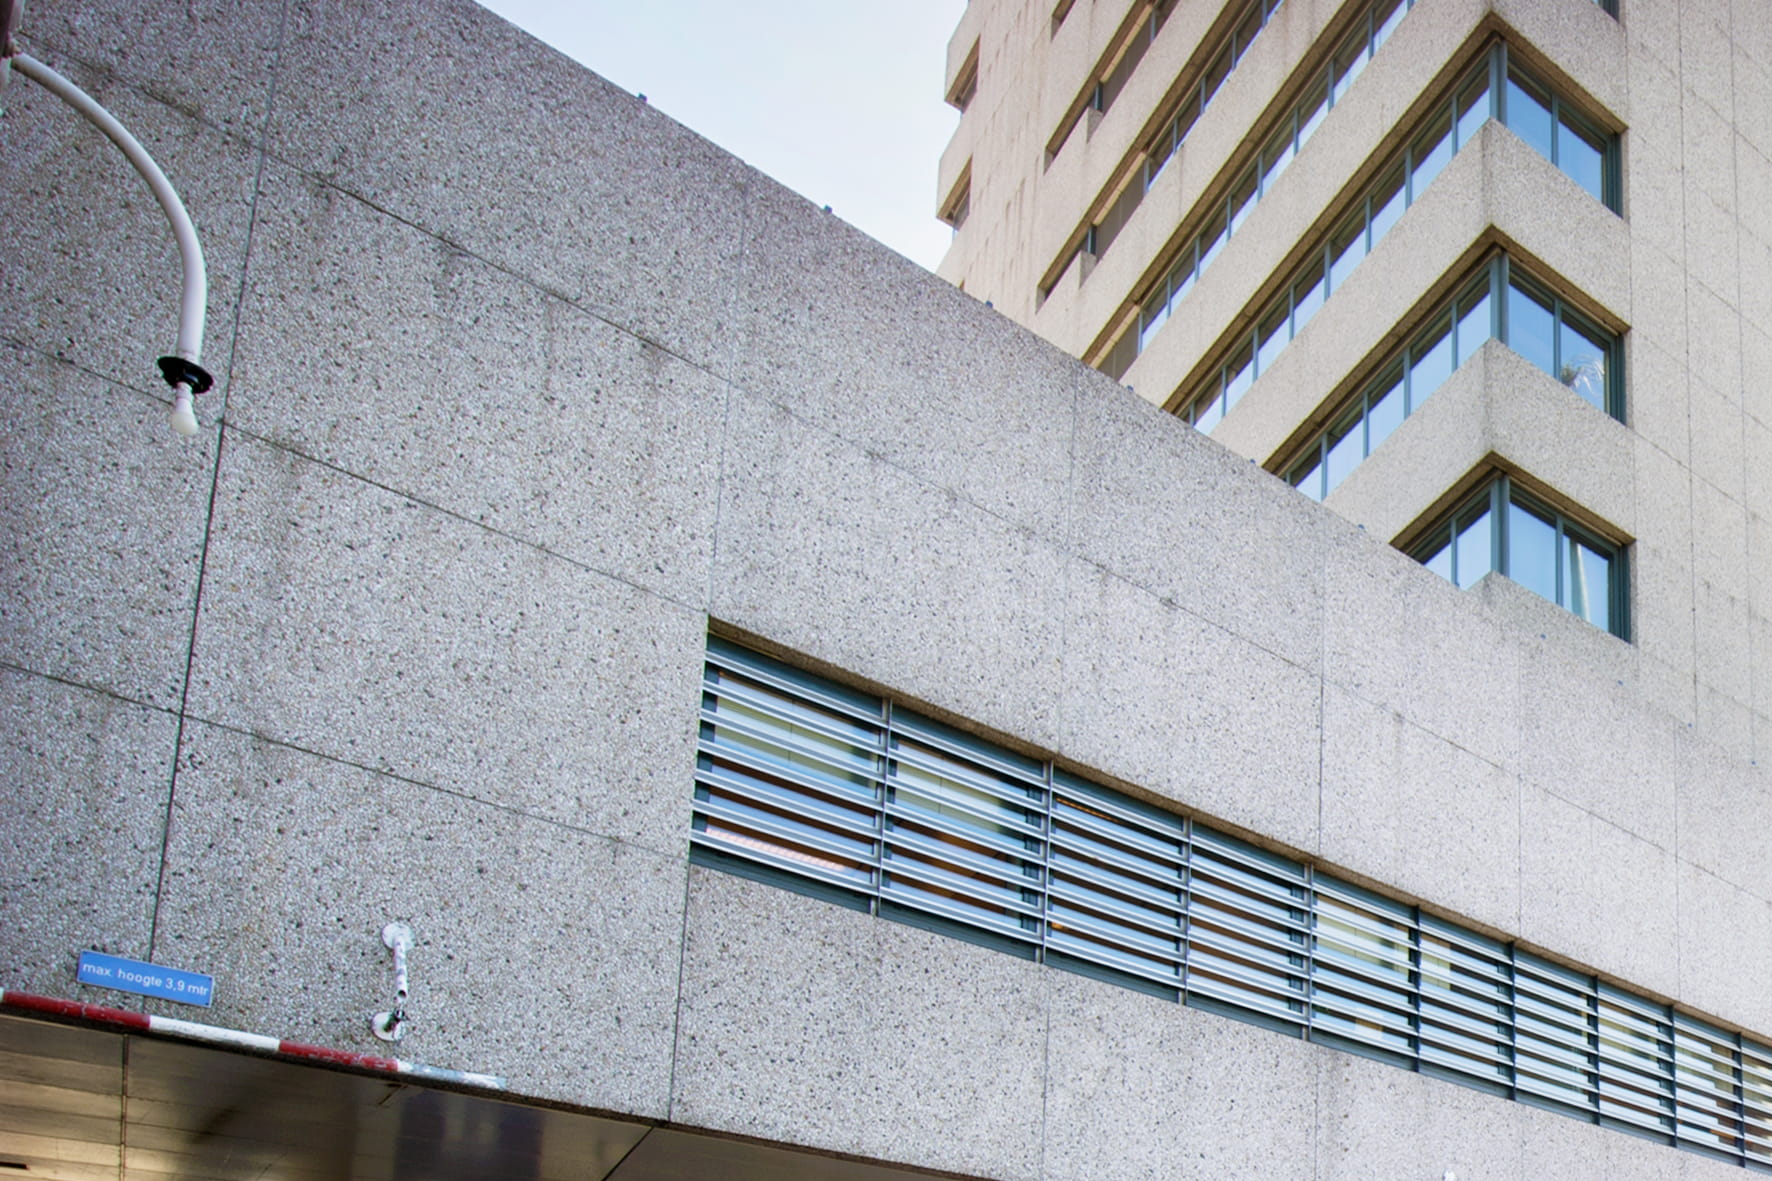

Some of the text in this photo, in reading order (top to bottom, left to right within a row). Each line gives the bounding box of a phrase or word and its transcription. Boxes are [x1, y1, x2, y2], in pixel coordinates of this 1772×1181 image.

[82, 962, 209, 996] max hoogte 3,9 mtr
